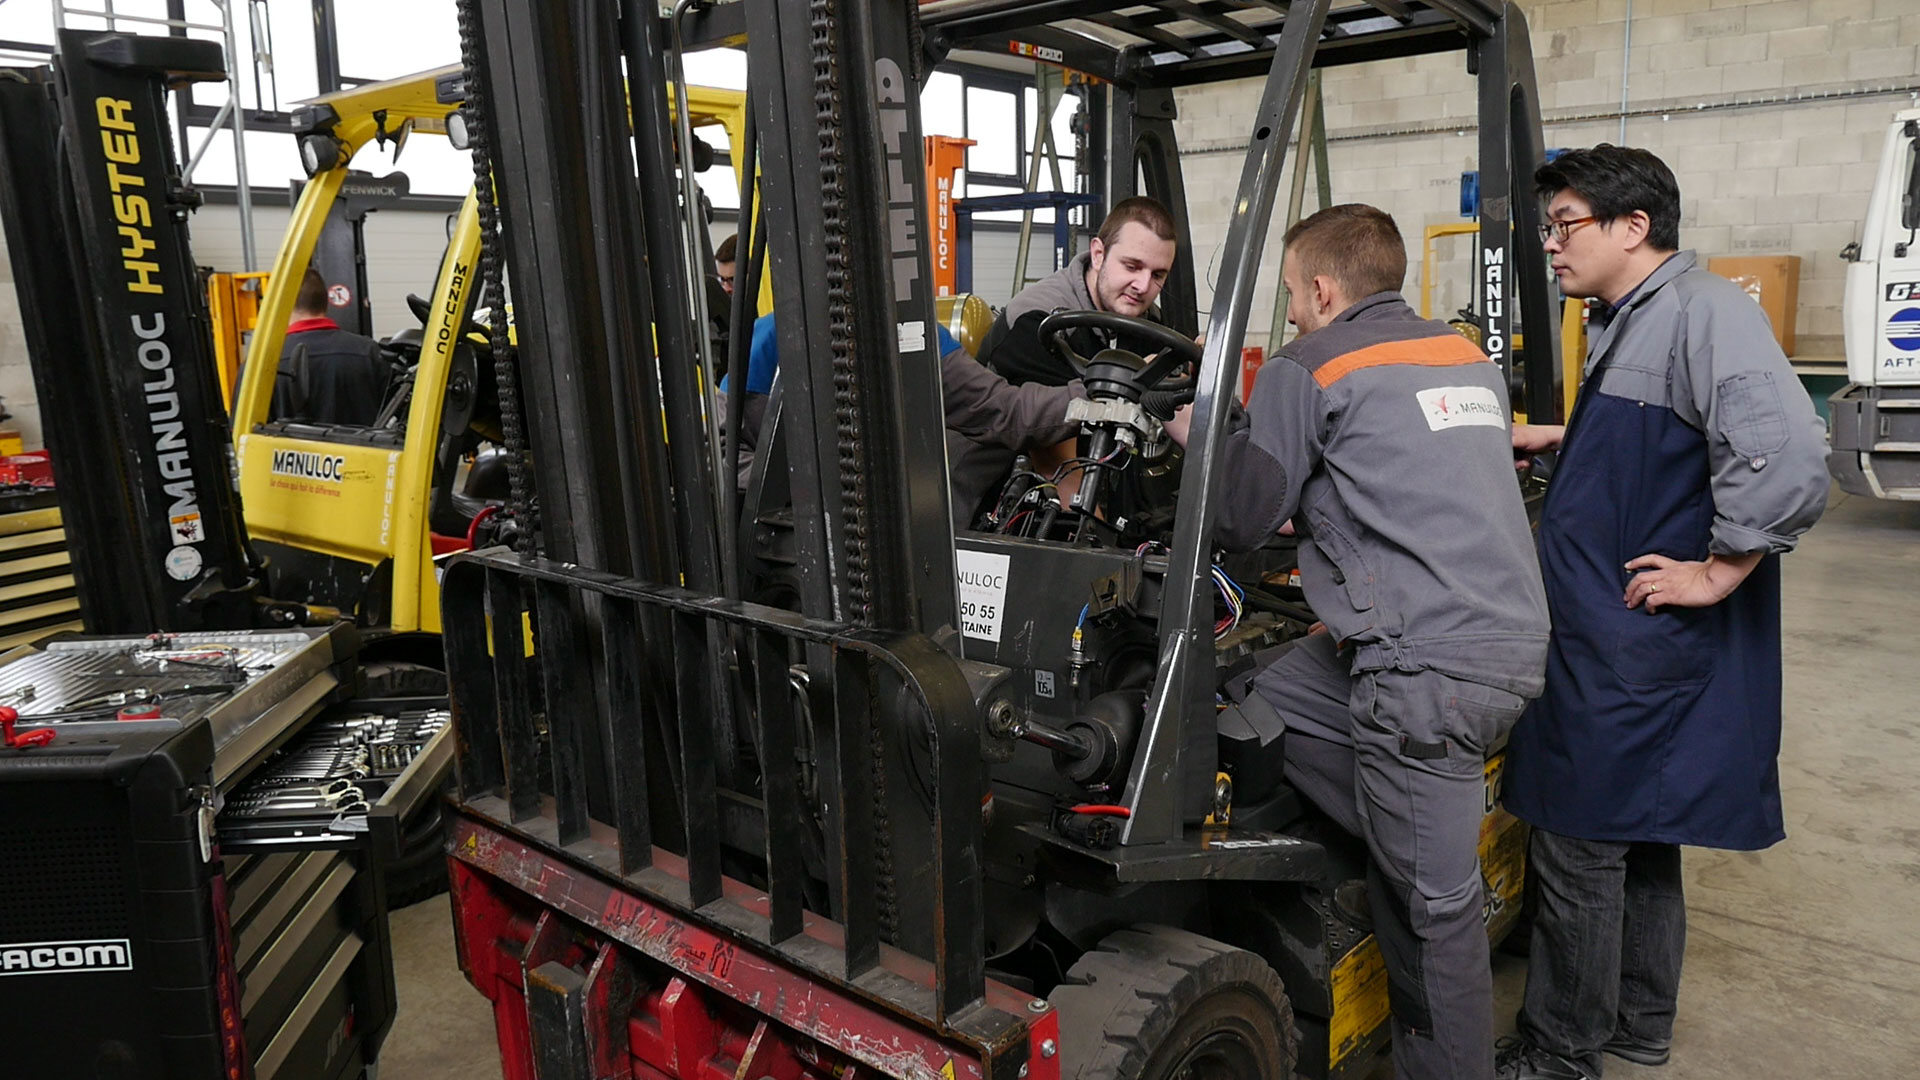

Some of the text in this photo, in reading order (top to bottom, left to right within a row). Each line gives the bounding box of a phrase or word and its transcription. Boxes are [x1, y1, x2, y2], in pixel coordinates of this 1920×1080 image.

[96, 96, 164, 294] HYSTER
[343, 184, 397, 196] FENWICK
[938, 177, 949, 270] MANULOC
[436, 262, 468, 355] MANULOC
[131, 312, 200, 515] MANULOC
[272, 451, 343, 481] MANULOC
[961, 621, 993, 636] TAINE
[980, 605, 995, 620] 55
